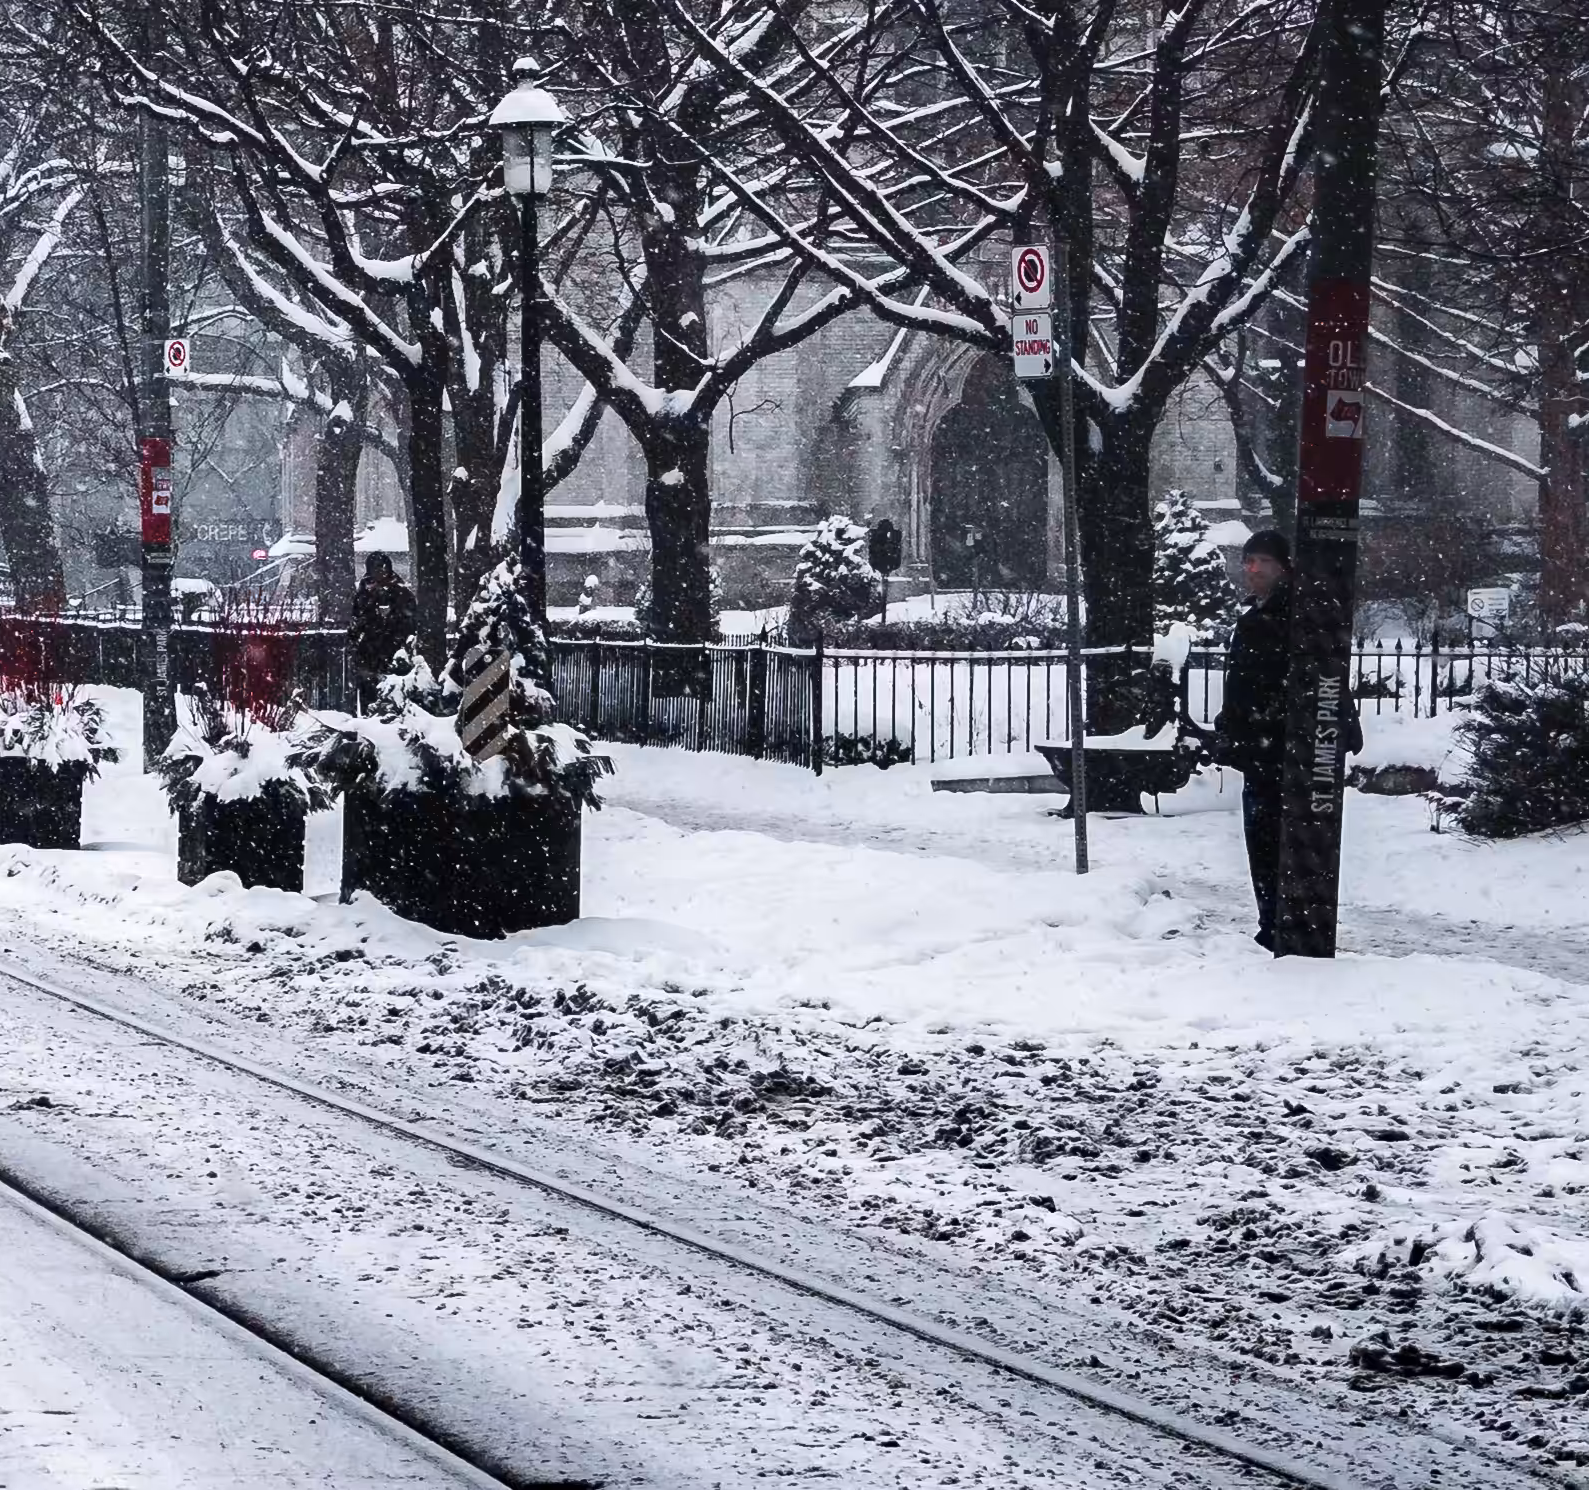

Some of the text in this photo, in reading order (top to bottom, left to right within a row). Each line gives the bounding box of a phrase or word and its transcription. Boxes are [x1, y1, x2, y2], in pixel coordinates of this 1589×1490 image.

[1025, 318, 1039, 335] NO
[1015, 338, 1051, 356] STANDING
[1317, 674, 1341, 721] PARK
[1312, 724, 1339, 784] JAMES
